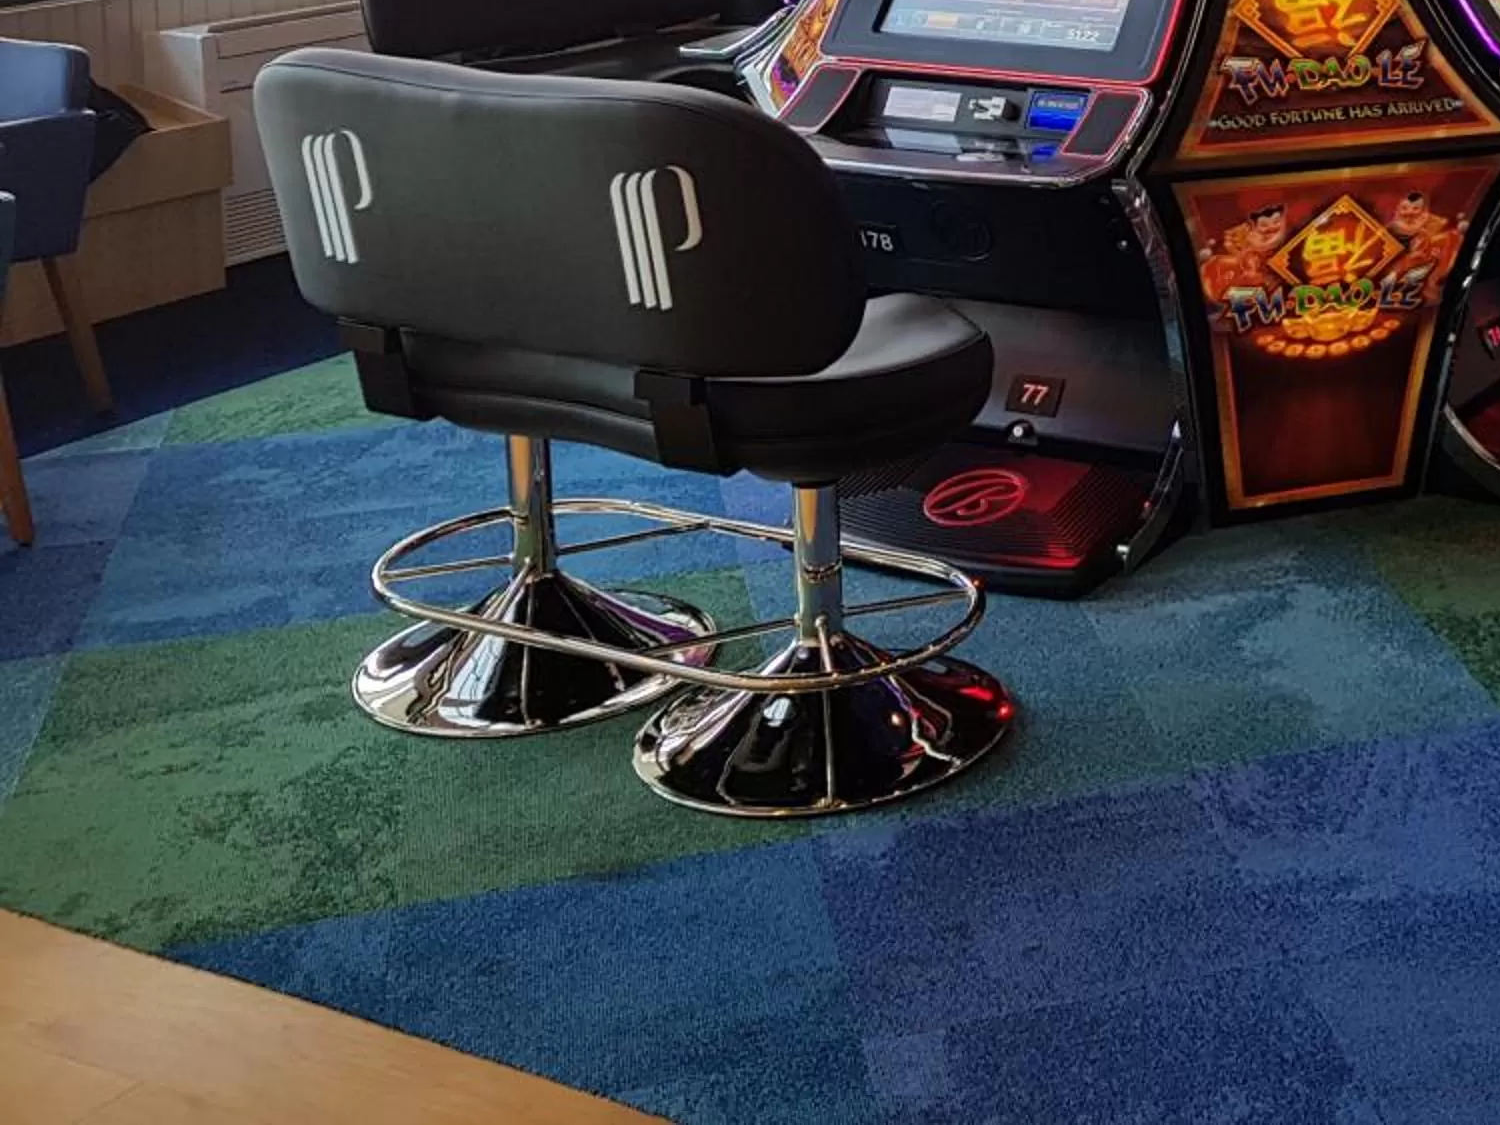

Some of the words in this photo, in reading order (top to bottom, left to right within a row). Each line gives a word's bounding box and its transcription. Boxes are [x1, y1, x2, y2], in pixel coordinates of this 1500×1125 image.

[1292, 55, 1372, 92] DAO
[1374, 38, 1429, 89] LE
[1217, 112, 1266, 131] GOOD
[1270, 106, 1345, 126] FORTUNE
[1349, 103, 1383, 119] HAS
[1387, 97, 1454, 116] ARRIVED
[1293, 278, 1375, 315] DAO
[1020, 383, 1049, 406] 77
